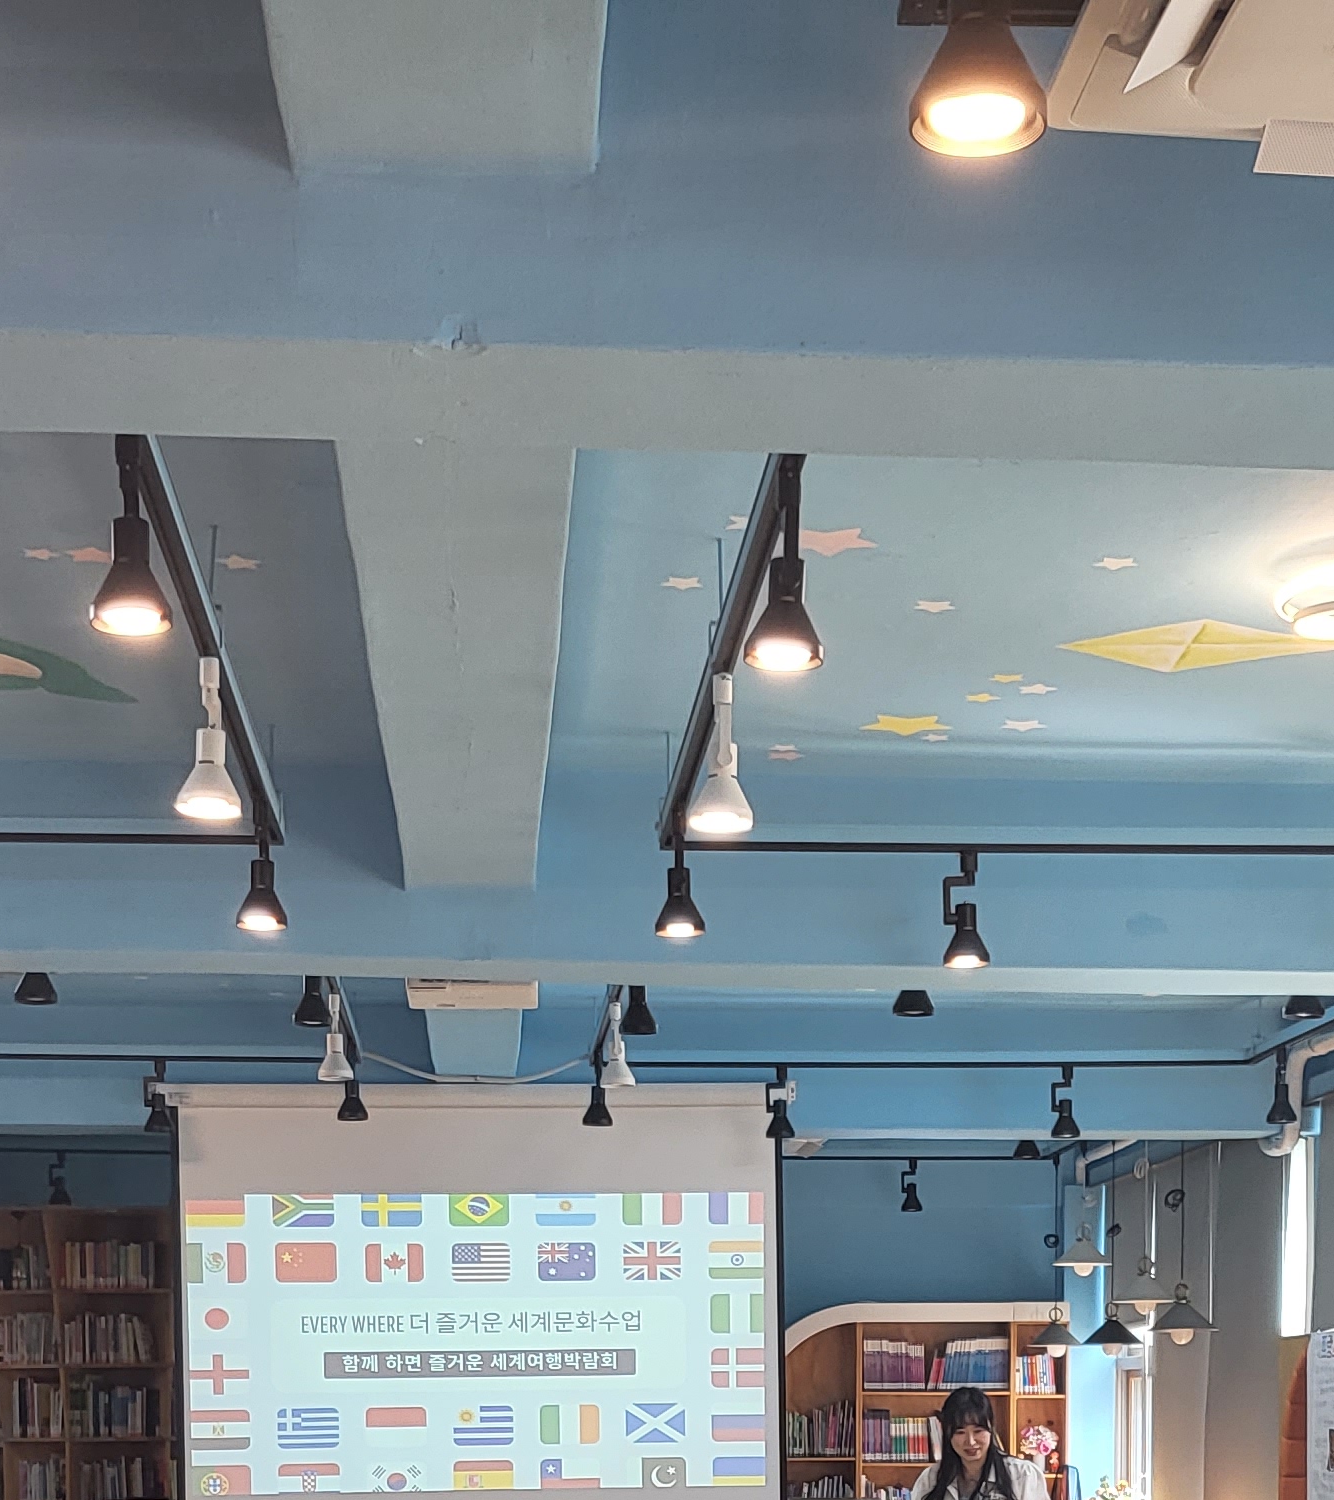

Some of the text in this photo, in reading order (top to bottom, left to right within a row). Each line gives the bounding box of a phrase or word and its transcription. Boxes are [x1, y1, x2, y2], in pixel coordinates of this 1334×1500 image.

[300, 1310, 642, 1334] EVERY WHERE 더 즐거운 세계문화수업
[341, 1351, 618, 1374] 함께 하면 즐거운 세계여행박람회
